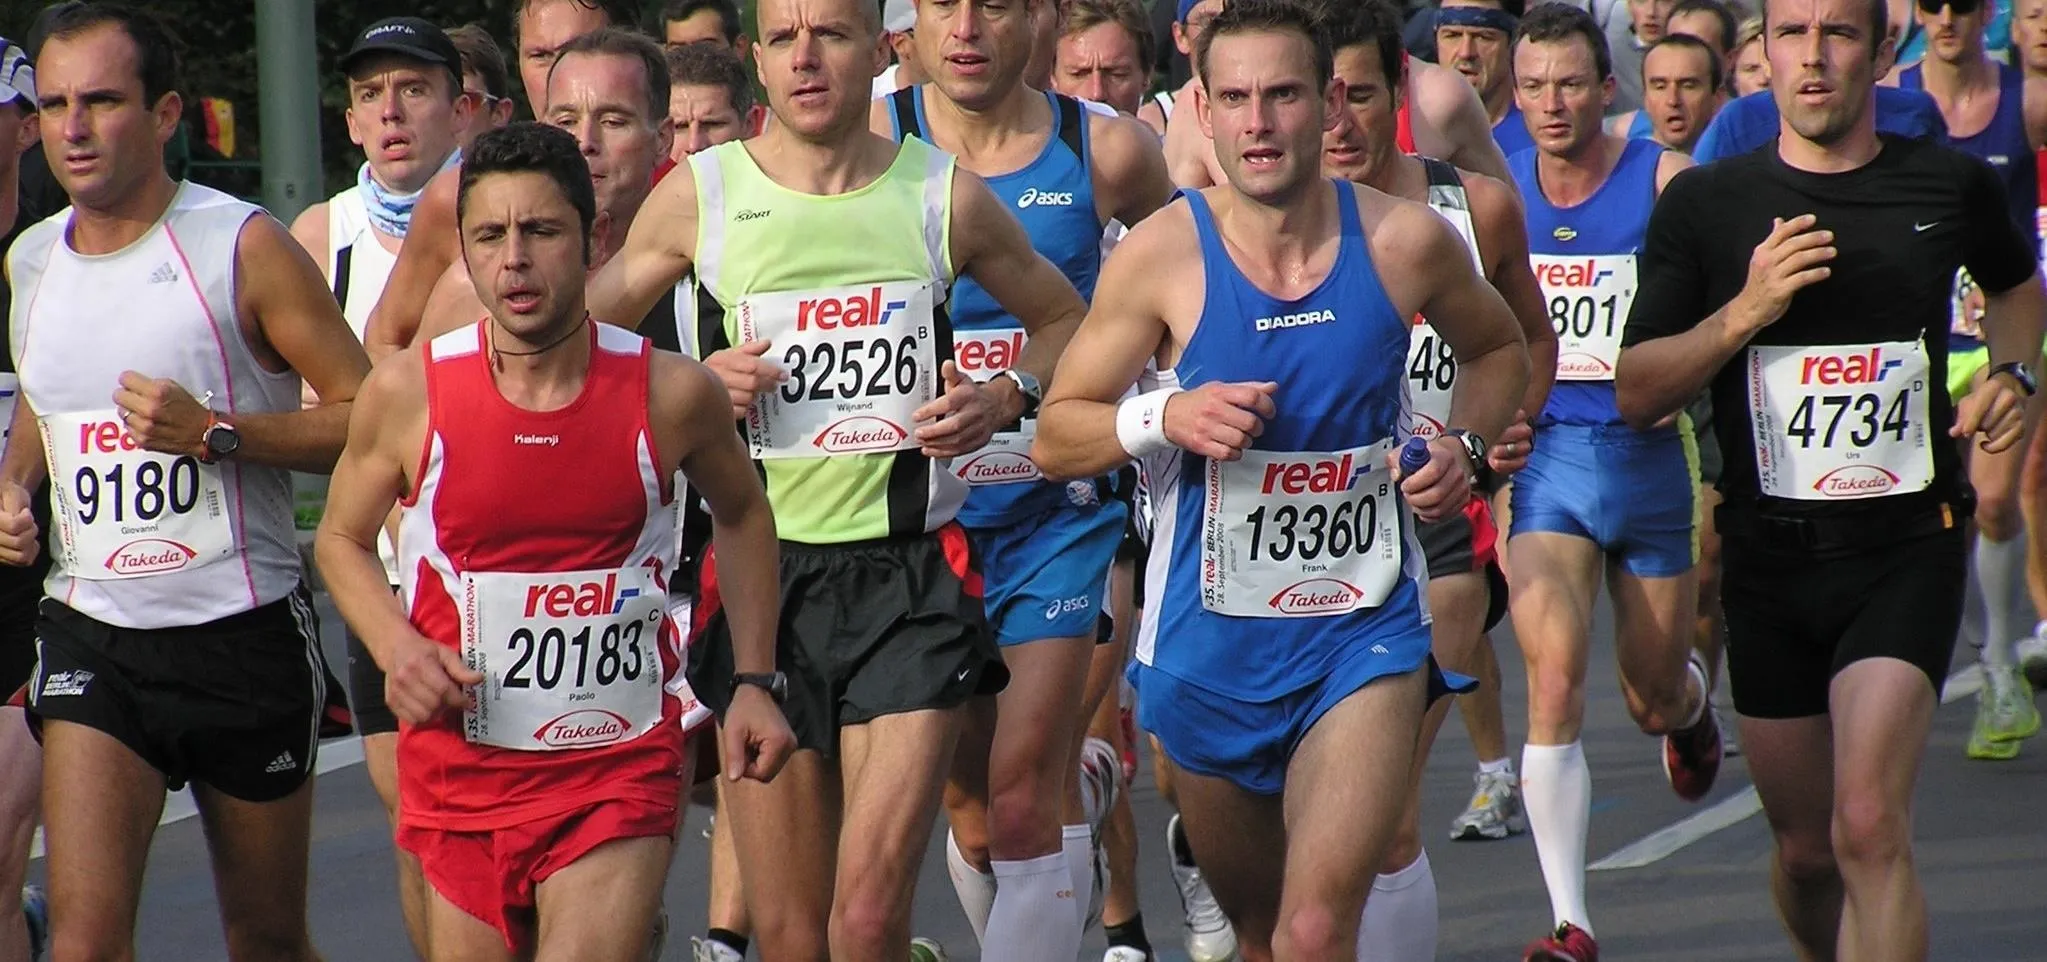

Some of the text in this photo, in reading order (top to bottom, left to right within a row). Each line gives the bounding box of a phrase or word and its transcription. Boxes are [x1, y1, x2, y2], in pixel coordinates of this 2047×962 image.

[1036, 191, 1073, 206] asics
[1255, 309, 1336, 332] DIADORA
[1550, 294, 1618, 339] 801
[918, 325, 928, 340] B
[780, 335, 918, 404] 32526
[1409, 335, 1456, 391] 48
[1914, 380, 1924, 392] D
[836, 401, 873, 413] Wijnand
[1787, 388, 1911, 449] 4734
[514, 434, 559, 447] Kalenji
[831, 427, 895, 446] Takeda
[973, 462, 1033, 477] Takeda
[75, 455, 200, 525] 9180
[1379, 483, 1388, 497] B
[1830, 476, 1888, 490] Takeda
[120, 523, 160, 535] Giovanni
[1246, 494, 1377, 561] 13360
[119, 548, 182, 568] Takeda
[1217, 545, 1228, 590] September
[1302, 563, 1329, 573] Frank
[1288, 590, 1352, 608] Takeda
[648, 608, 660, 622] C
[502, 618, 644, 690] 20183
[569, 692, 596, 701] Paolo
[554, 722, 618, 740] Takeda
